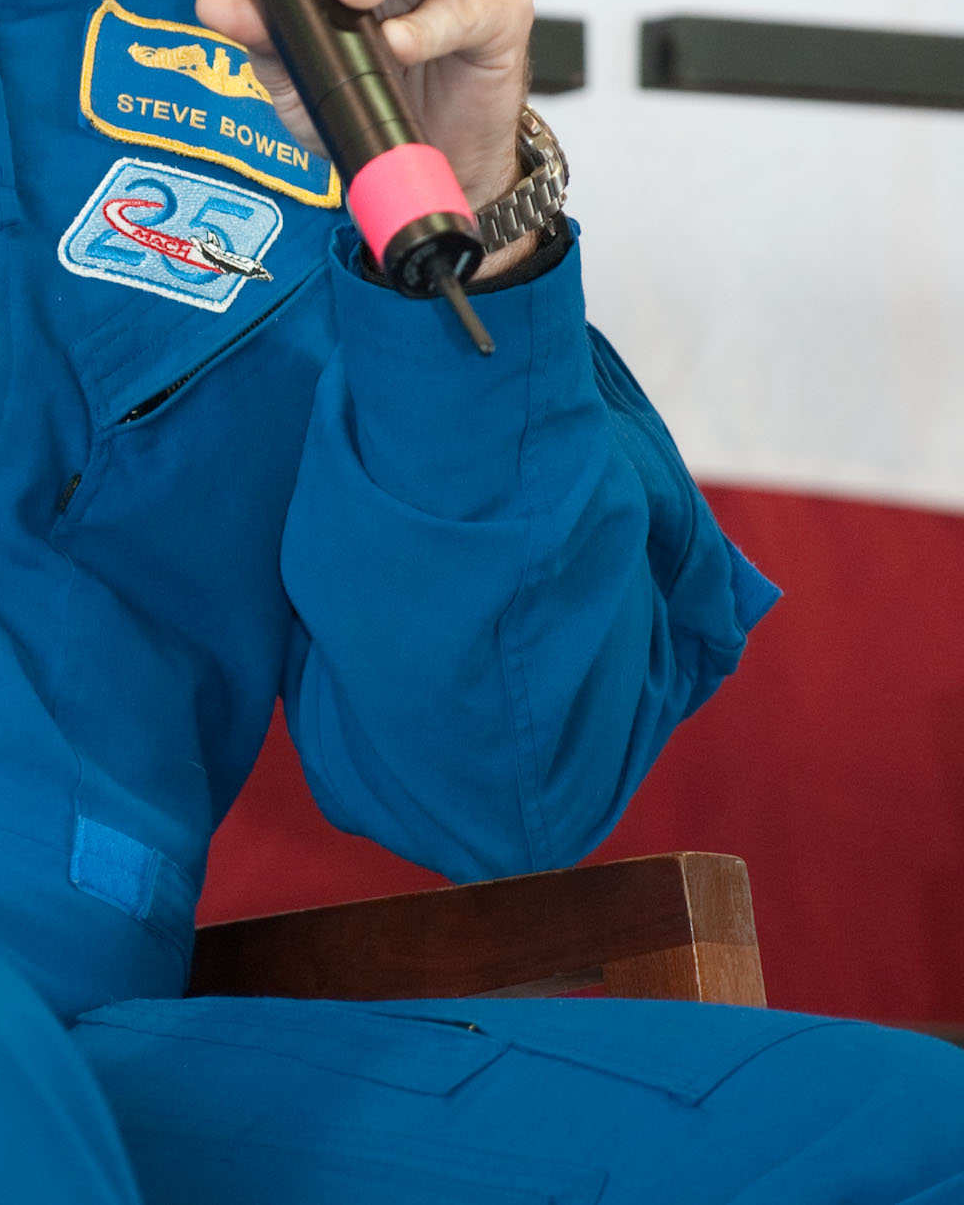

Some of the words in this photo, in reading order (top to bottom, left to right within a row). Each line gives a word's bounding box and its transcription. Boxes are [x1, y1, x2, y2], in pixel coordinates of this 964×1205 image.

[117, 94, 208, 130] STEVE
[219, 115, 310, 172] BOWEN
[85, 178, 255, 285] 25
[133, 229, 192, 260] MACH
